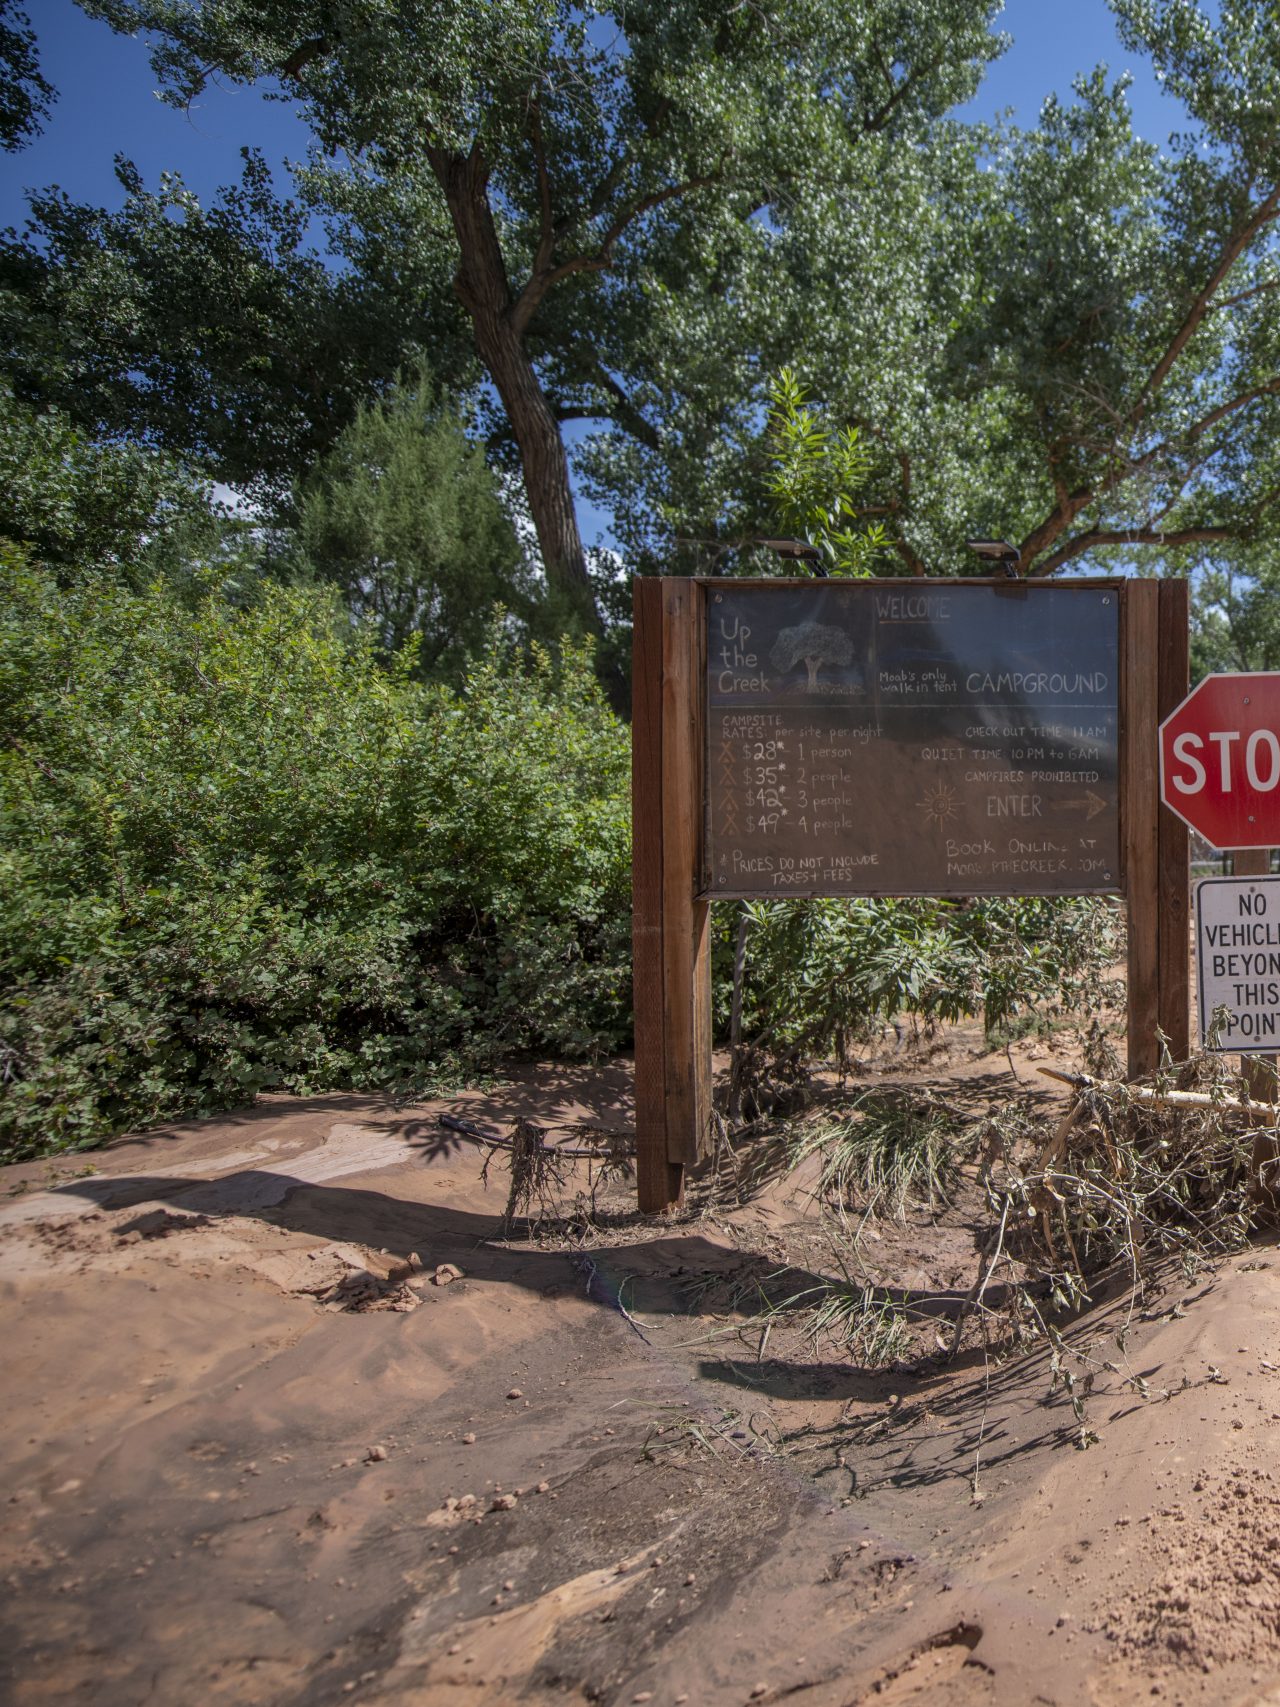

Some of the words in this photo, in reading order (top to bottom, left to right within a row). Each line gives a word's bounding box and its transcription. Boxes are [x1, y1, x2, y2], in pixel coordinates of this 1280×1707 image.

[876, 595, 951, 619] WELCOME
[720, 616, 752, 651] Up
[719, 645, 758, 668] the
[718, 670, 771, 694] Creek
[879, 670, 915, 682] Moab's
[922, 667, 947, 684] only
[965, 671, 1108, 694] CAMPGROUND
[880, 681, 914, 694] walk
[917, 681, 929, 693] in
[933, 682, 957, 693] tent
[722, 715, 783, 727] CAMPSITE
[965, 726, 999, 737] CHECK
[1003, 726, 1026, 737] OUT
[775, 728, 795, 741] per
[799, 725, 822, 738] site
[829, 728, 849, 743] per
[853, 723, 884, 745] night
[811, 747, 852, 763] person
[922, 747, 964, 760] QUIET
[1049, 748, 1064, 759] to
[797, 767, 807, 785] 2
[811, 768, 852, 790] people
[965, 770, 1024, 783] CAMPFIRES
[1031, 771, 1099, 783] PROHIBITED
[797, 790, 808, 808] 3
[813, 792, 853, 813] people
[987, 794, 1042, 817] ENTER
[797, 815, 808, 834] 4
[814, 815, 853, 836] people
[780, 857, 795, 870] DO
[799, 856, 824, 869] NOT
[831, 854, 880, 867] INCLUDE
[823, 869, 853, 882] FEES
[1238, 893, 1267, 917] NO
[1232, 982, 1280, 1006] THIS
